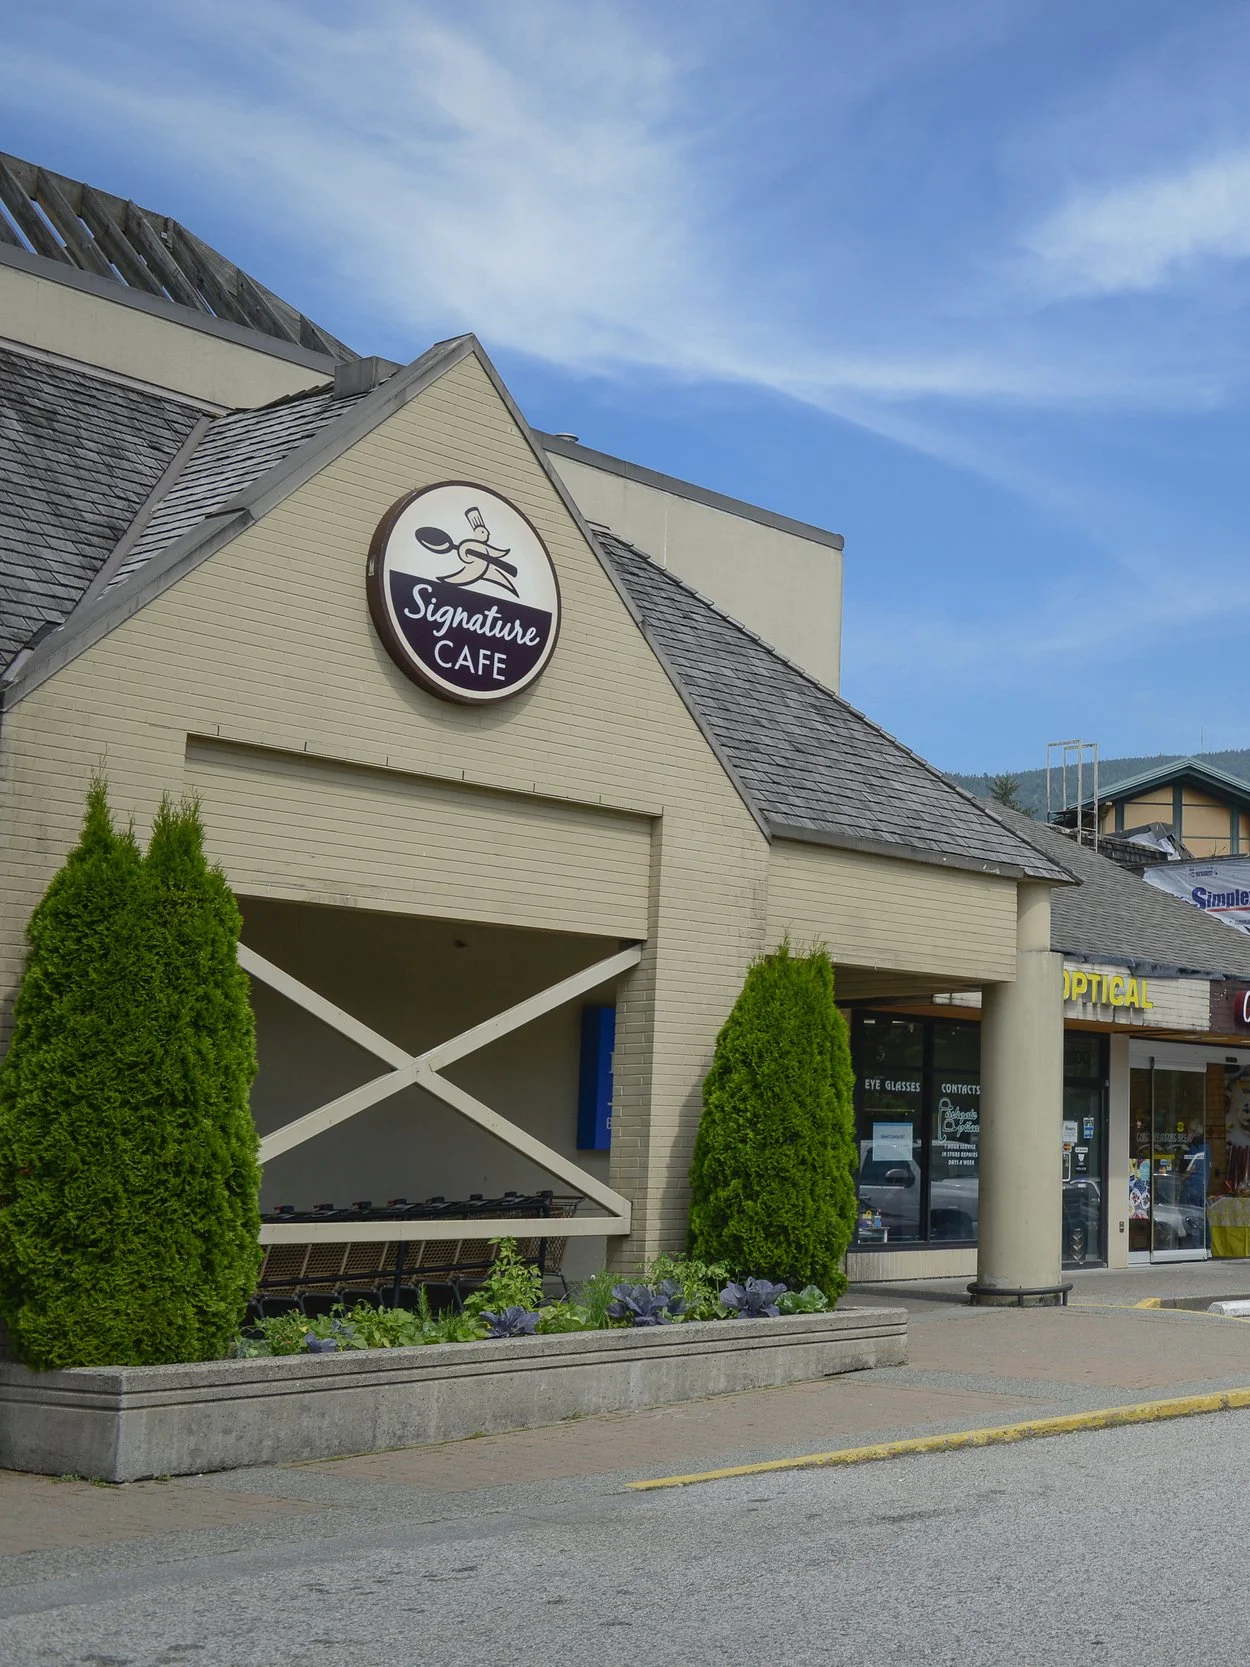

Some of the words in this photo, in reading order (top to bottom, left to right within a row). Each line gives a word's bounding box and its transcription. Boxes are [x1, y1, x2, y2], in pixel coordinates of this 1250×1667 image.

[404, 584, 540, 646] Signature
[434, 640, 507, 681] CAFE
[865, 1079, 880, 1090] EYE
[885, 1080, 920, 1092] GLASSES
[941, 1083, 980, 1095] CONTACTS
